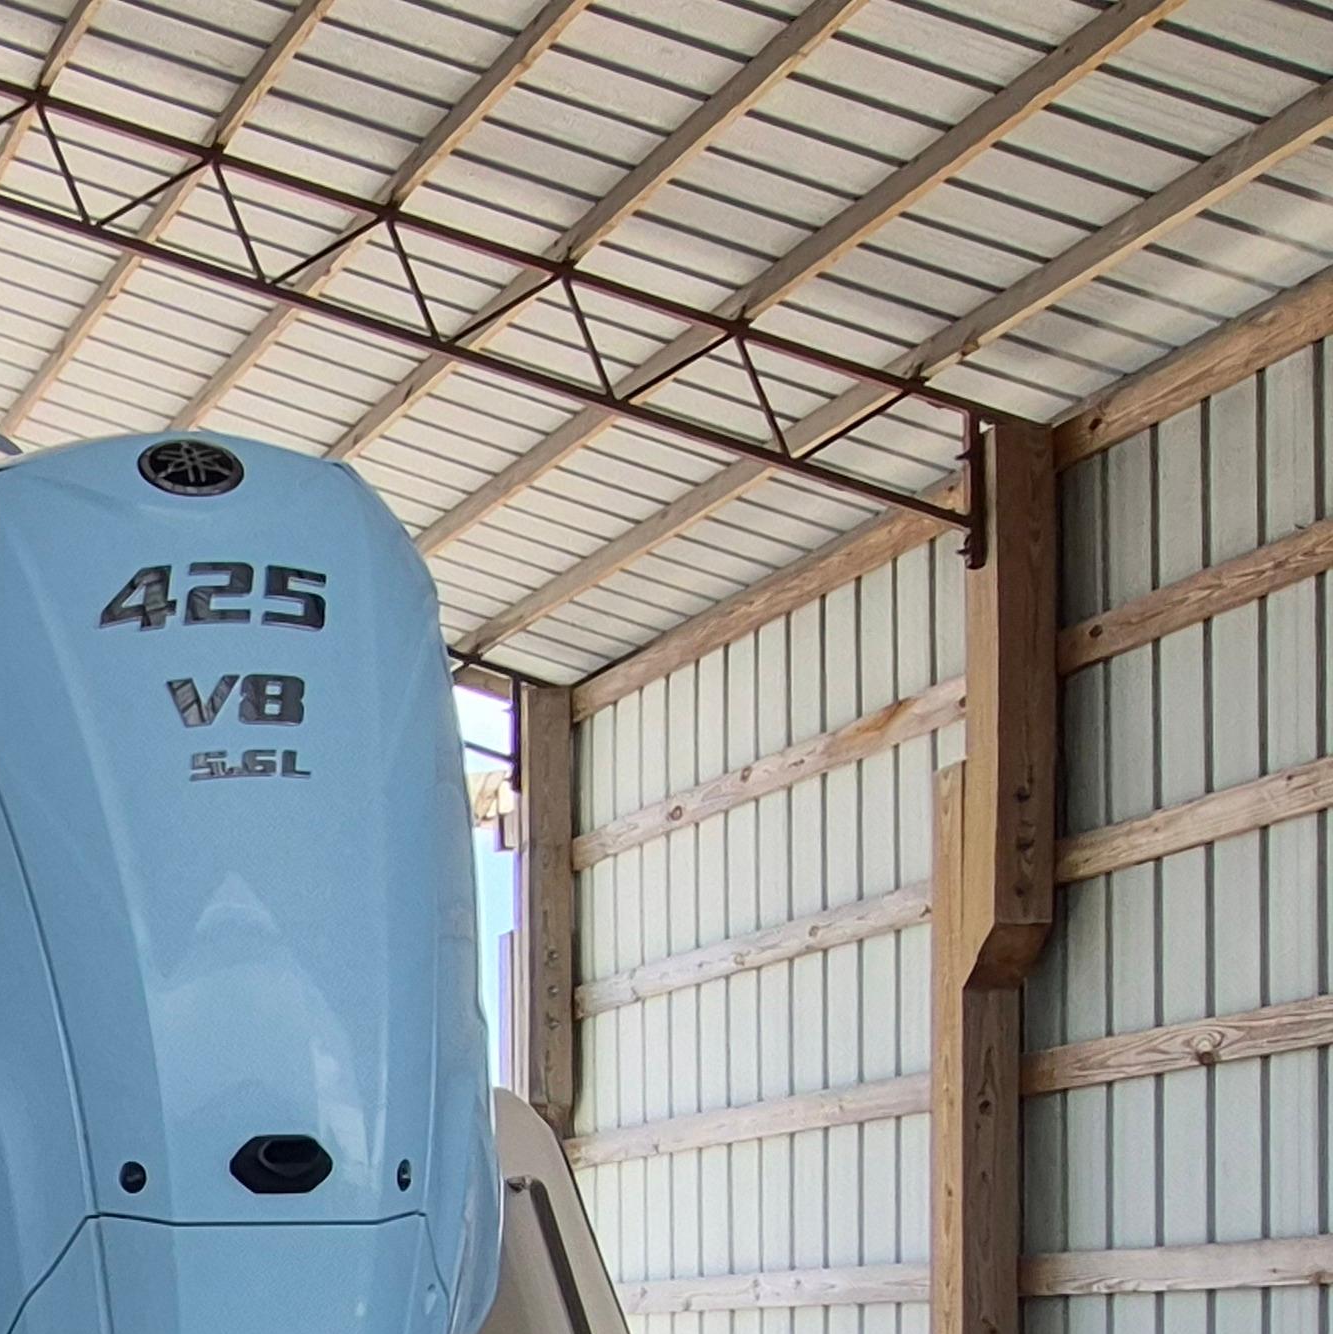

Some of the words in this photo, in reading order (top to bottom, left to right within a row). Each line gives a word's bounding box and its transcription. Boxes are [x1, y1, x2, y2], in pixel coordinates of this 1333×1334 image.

[98, 561, 327, 633] 425
[166, 672, 307, 728] V8
[189, 748, 312, 782] 5.6L
